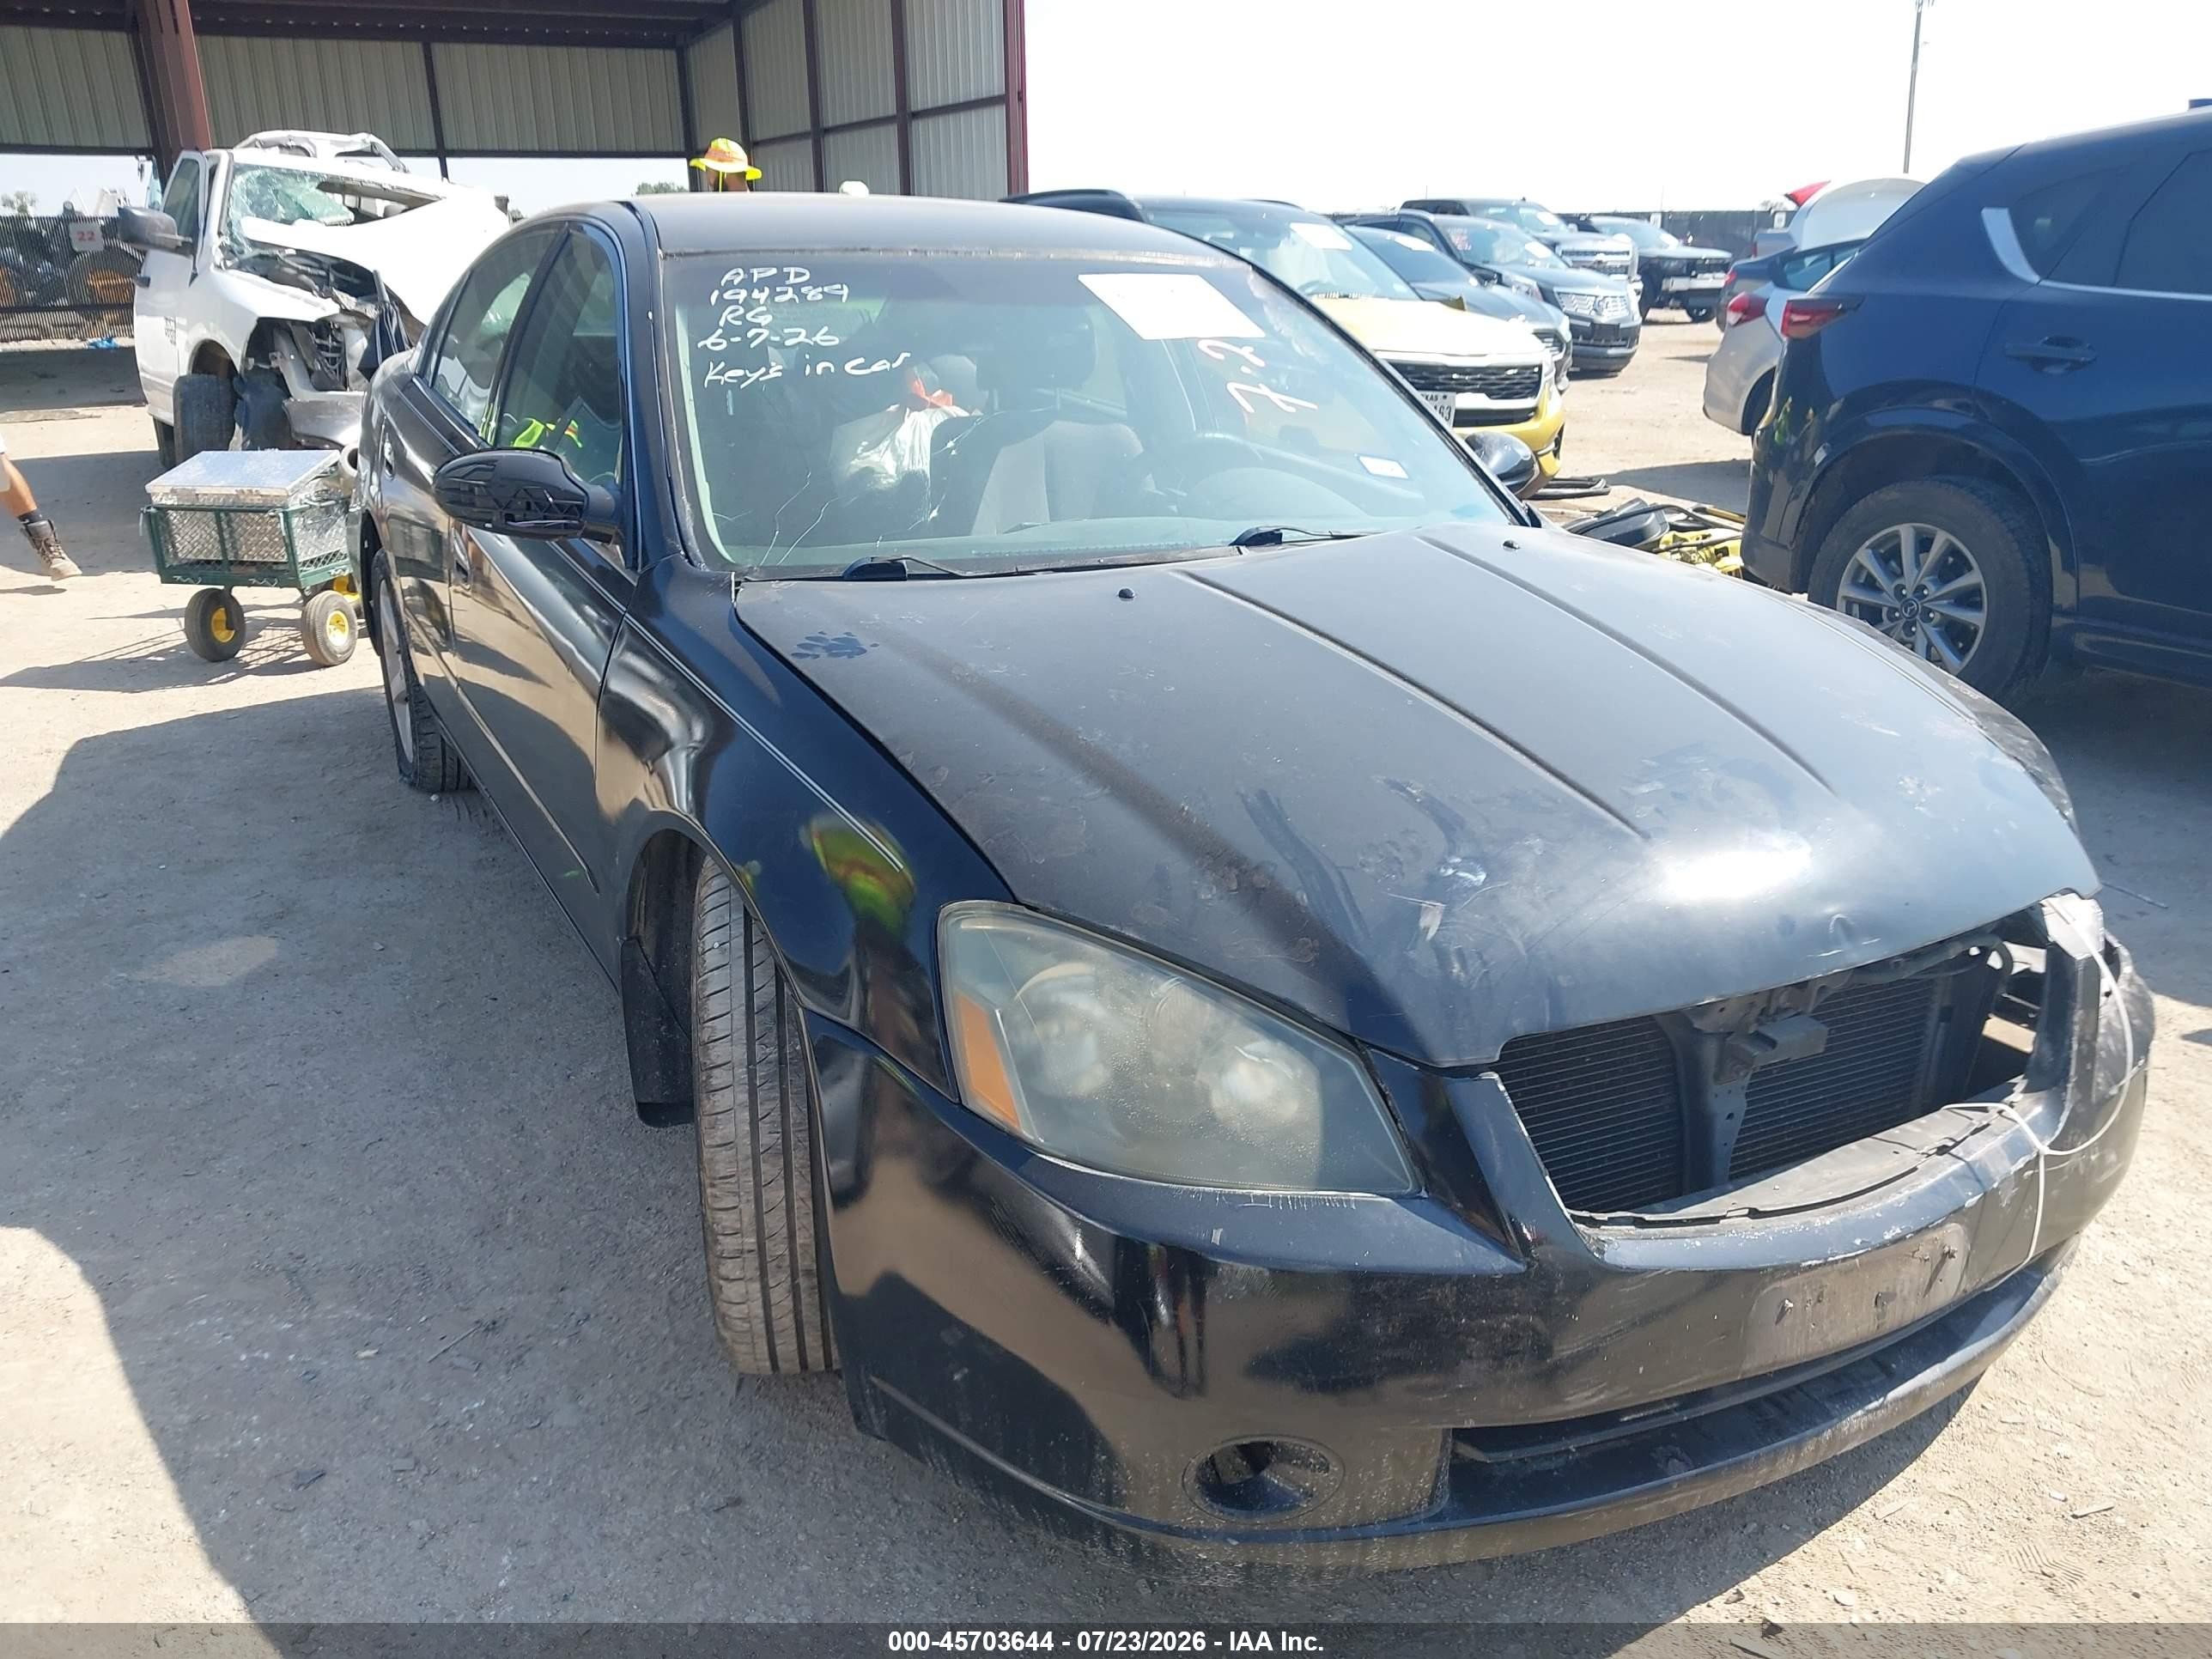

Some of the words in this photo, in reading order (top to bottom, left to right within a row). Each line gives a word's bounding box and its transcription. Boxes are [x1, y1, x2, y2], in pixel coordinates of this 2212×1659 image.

[76, 230, 95, 241] 22
[720, 266, 811, 287] APD
[719, 305, 773, 327] RG
[697, 325, 840, 350] 6-7-26
[805, 354, 835, 376] in
